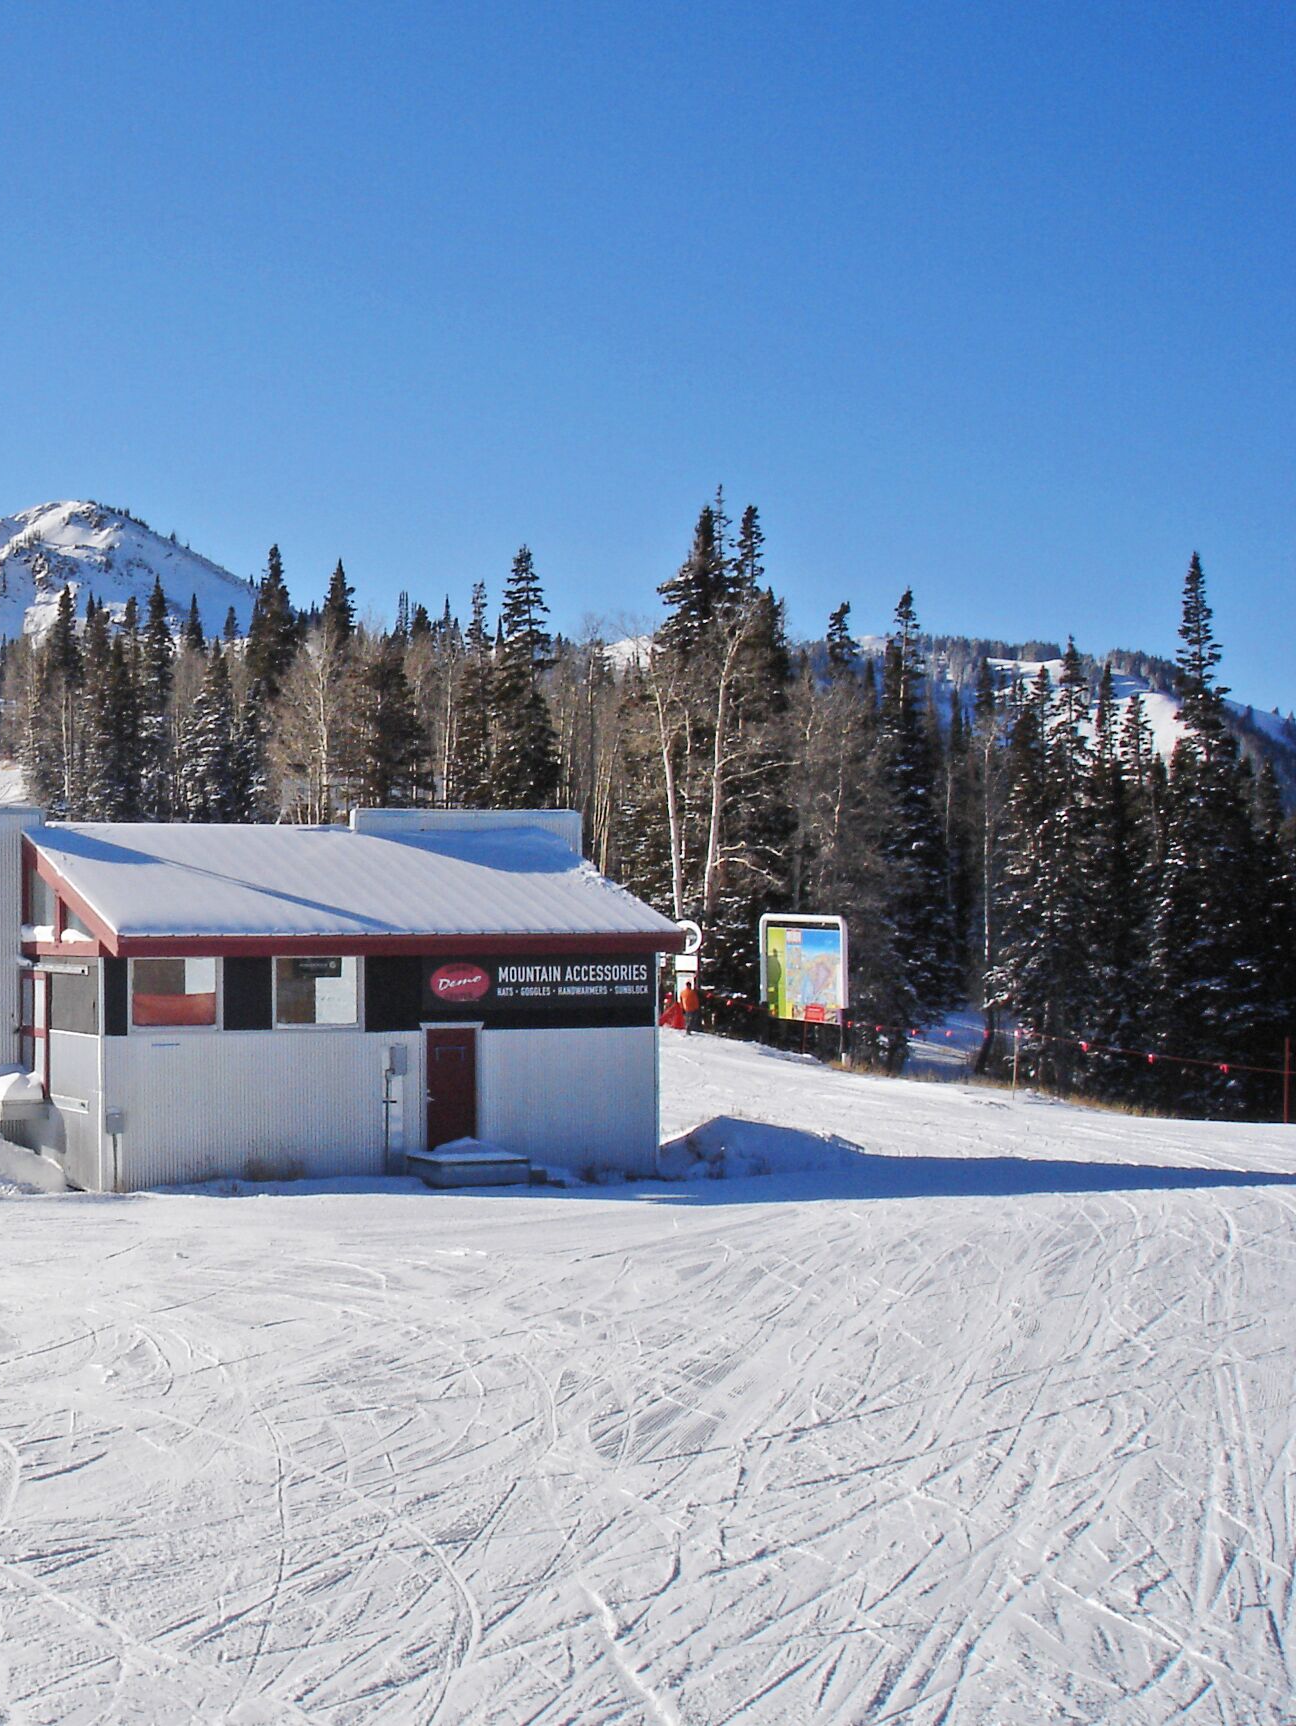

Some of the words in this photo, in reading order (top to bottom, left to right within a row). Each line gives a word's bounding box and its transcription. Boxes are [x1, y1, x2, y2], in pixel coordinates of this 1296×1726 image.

[498, 966, 561, 983] MOUNTAIN
[565, 964, 647, 981] ACCESSORIES
[438, 975, 482, 991] Demo
[520, 986, 551, 996] GOGGLES
[558, 985, 608, 995] HANDWARMERS
[614, 985, 648, 994] SUNBLOCK
